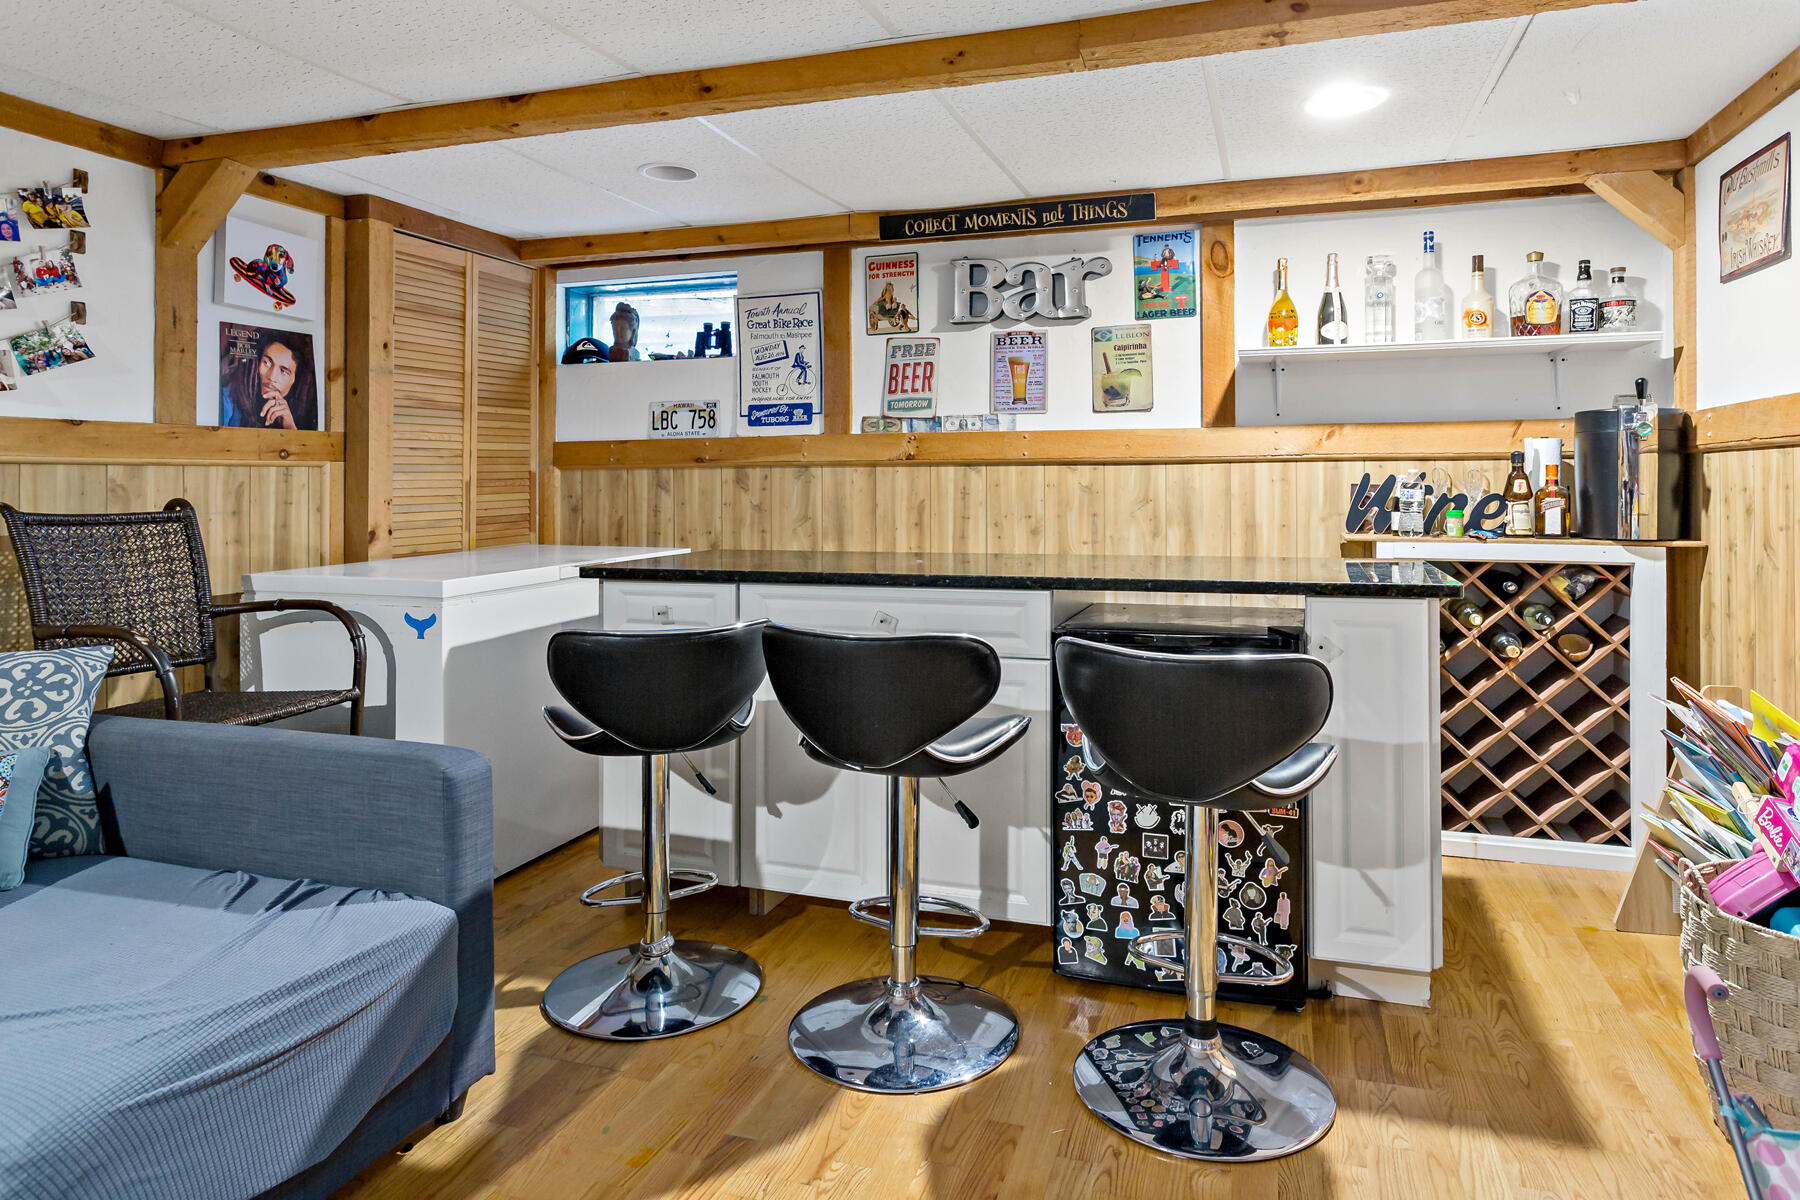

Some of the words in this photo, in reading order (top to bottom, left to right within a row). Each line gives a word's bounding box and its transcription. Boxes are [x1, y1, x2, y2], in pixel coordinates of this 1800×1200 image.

[904, 213, 960, 236] COLLECT
[964, 207, 1037, 230] MOMENTS
[1042, 203, 1065, 226] not
[1068, 200, 1128, 221] THINGS
[1136, 230, 1192, 247] TENNENT'S
[868, 259, 915, 272] GUINNESS
[882, 270, 915, 278] STRENGTH
[950, 256, 1113, 325] Bar
[772, 302, 808, 318] Annual
[1137, 309, 1168, 318] LAGER
[1170, 308, 1196, 317] BEER
[746, 319, 772, 330] Great
[773, 317, 792, 329] Bike
[792, 317, 814, 329] Race
[225, 327, 260, 339] LEGEND
[750, 332, 779, 340] Falmouth
[786, 331, 812, 340] Mashpee
[1115, 331, 1150, 340] LEBLON
[996, 336, 1043, 346] BEER
[229, 347, 257, 356] MARLEY
[754, 343, 781, 355] MONDAY
[890, 342, 936, 359] FREE
[1113, 343, 1147, 352] Caipirinha
[751, 372, 780, 380] FALMOUTH
[887, 361, 935, 395] BEER
[890, 399, 929, 409] TOMORROW
[652, 410, 678, 431] LBC
[688, 408, 716, 430] 758
[760, 415, 789, 424] TUBORG
[1757, 806, 1783, 848] Barbie
